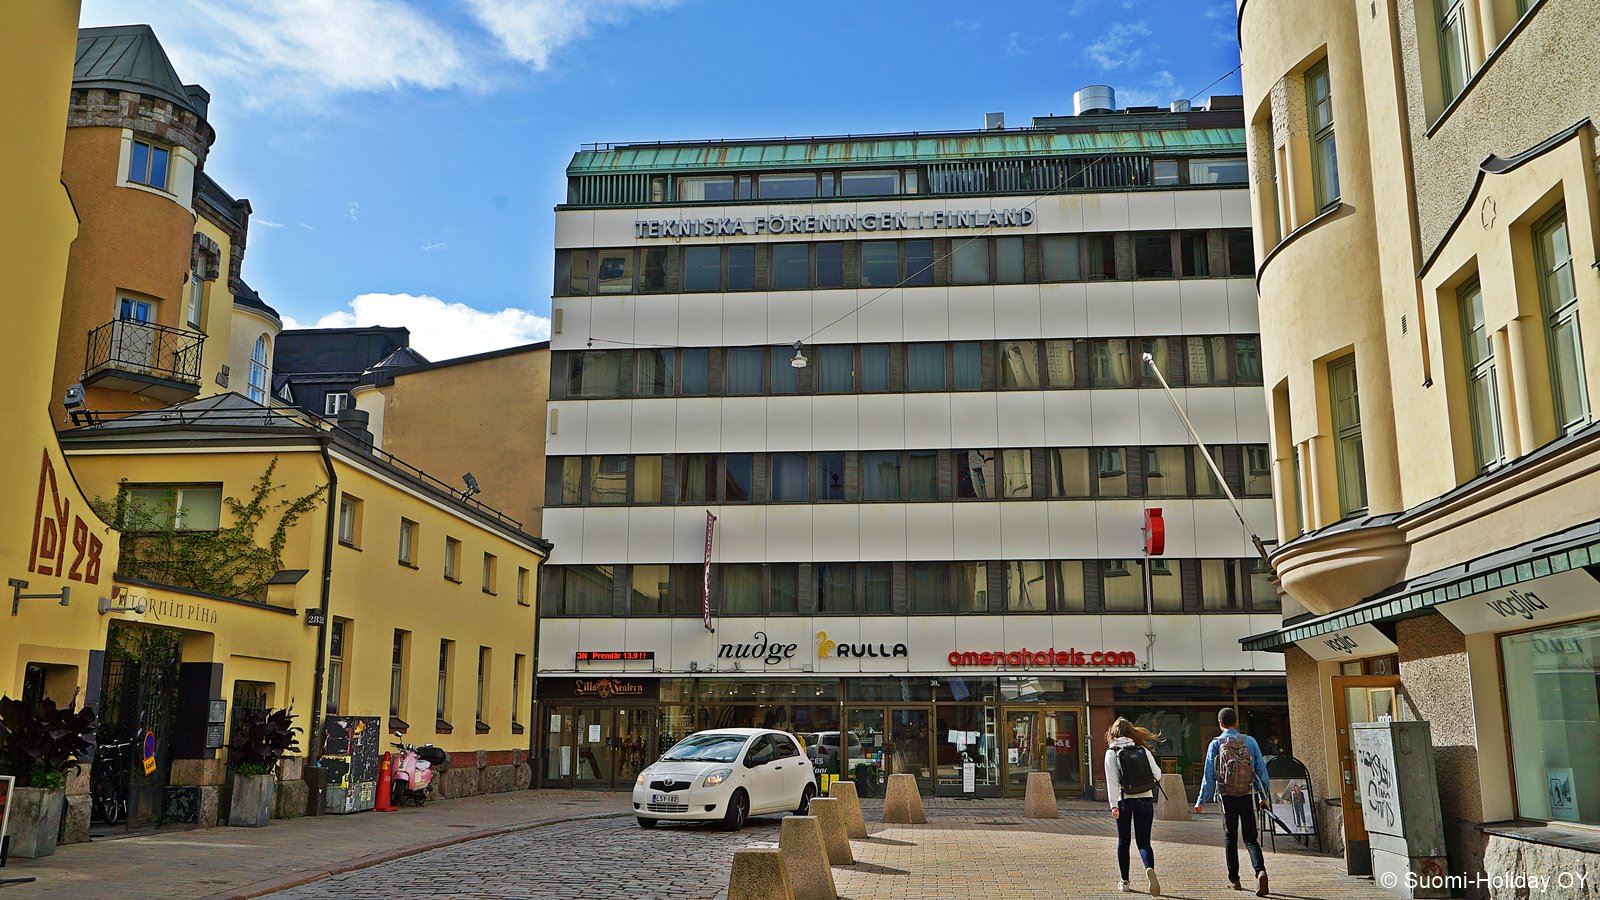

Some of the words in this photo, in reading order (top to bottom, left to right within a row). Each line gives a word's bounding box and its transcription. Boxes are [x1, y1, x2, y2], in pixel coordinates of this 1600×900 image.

[635, 216, 746, 239] TEKNISKA
[754, 211, 908, 234] FÖRENINGEN
[918, 212, 924, 228] I
[933, 207, 1037, 228] FINLAND
[1486, 589, 1550, 620] voglia
[717, 631, 798, 665] nudge
[837, 643, 907, 657] RULLA
[1323, 632, 1359, 654] voglia
[947, 648, 1136, 667] omenahotels.com
[574, 679, 598, 695] Lilla
